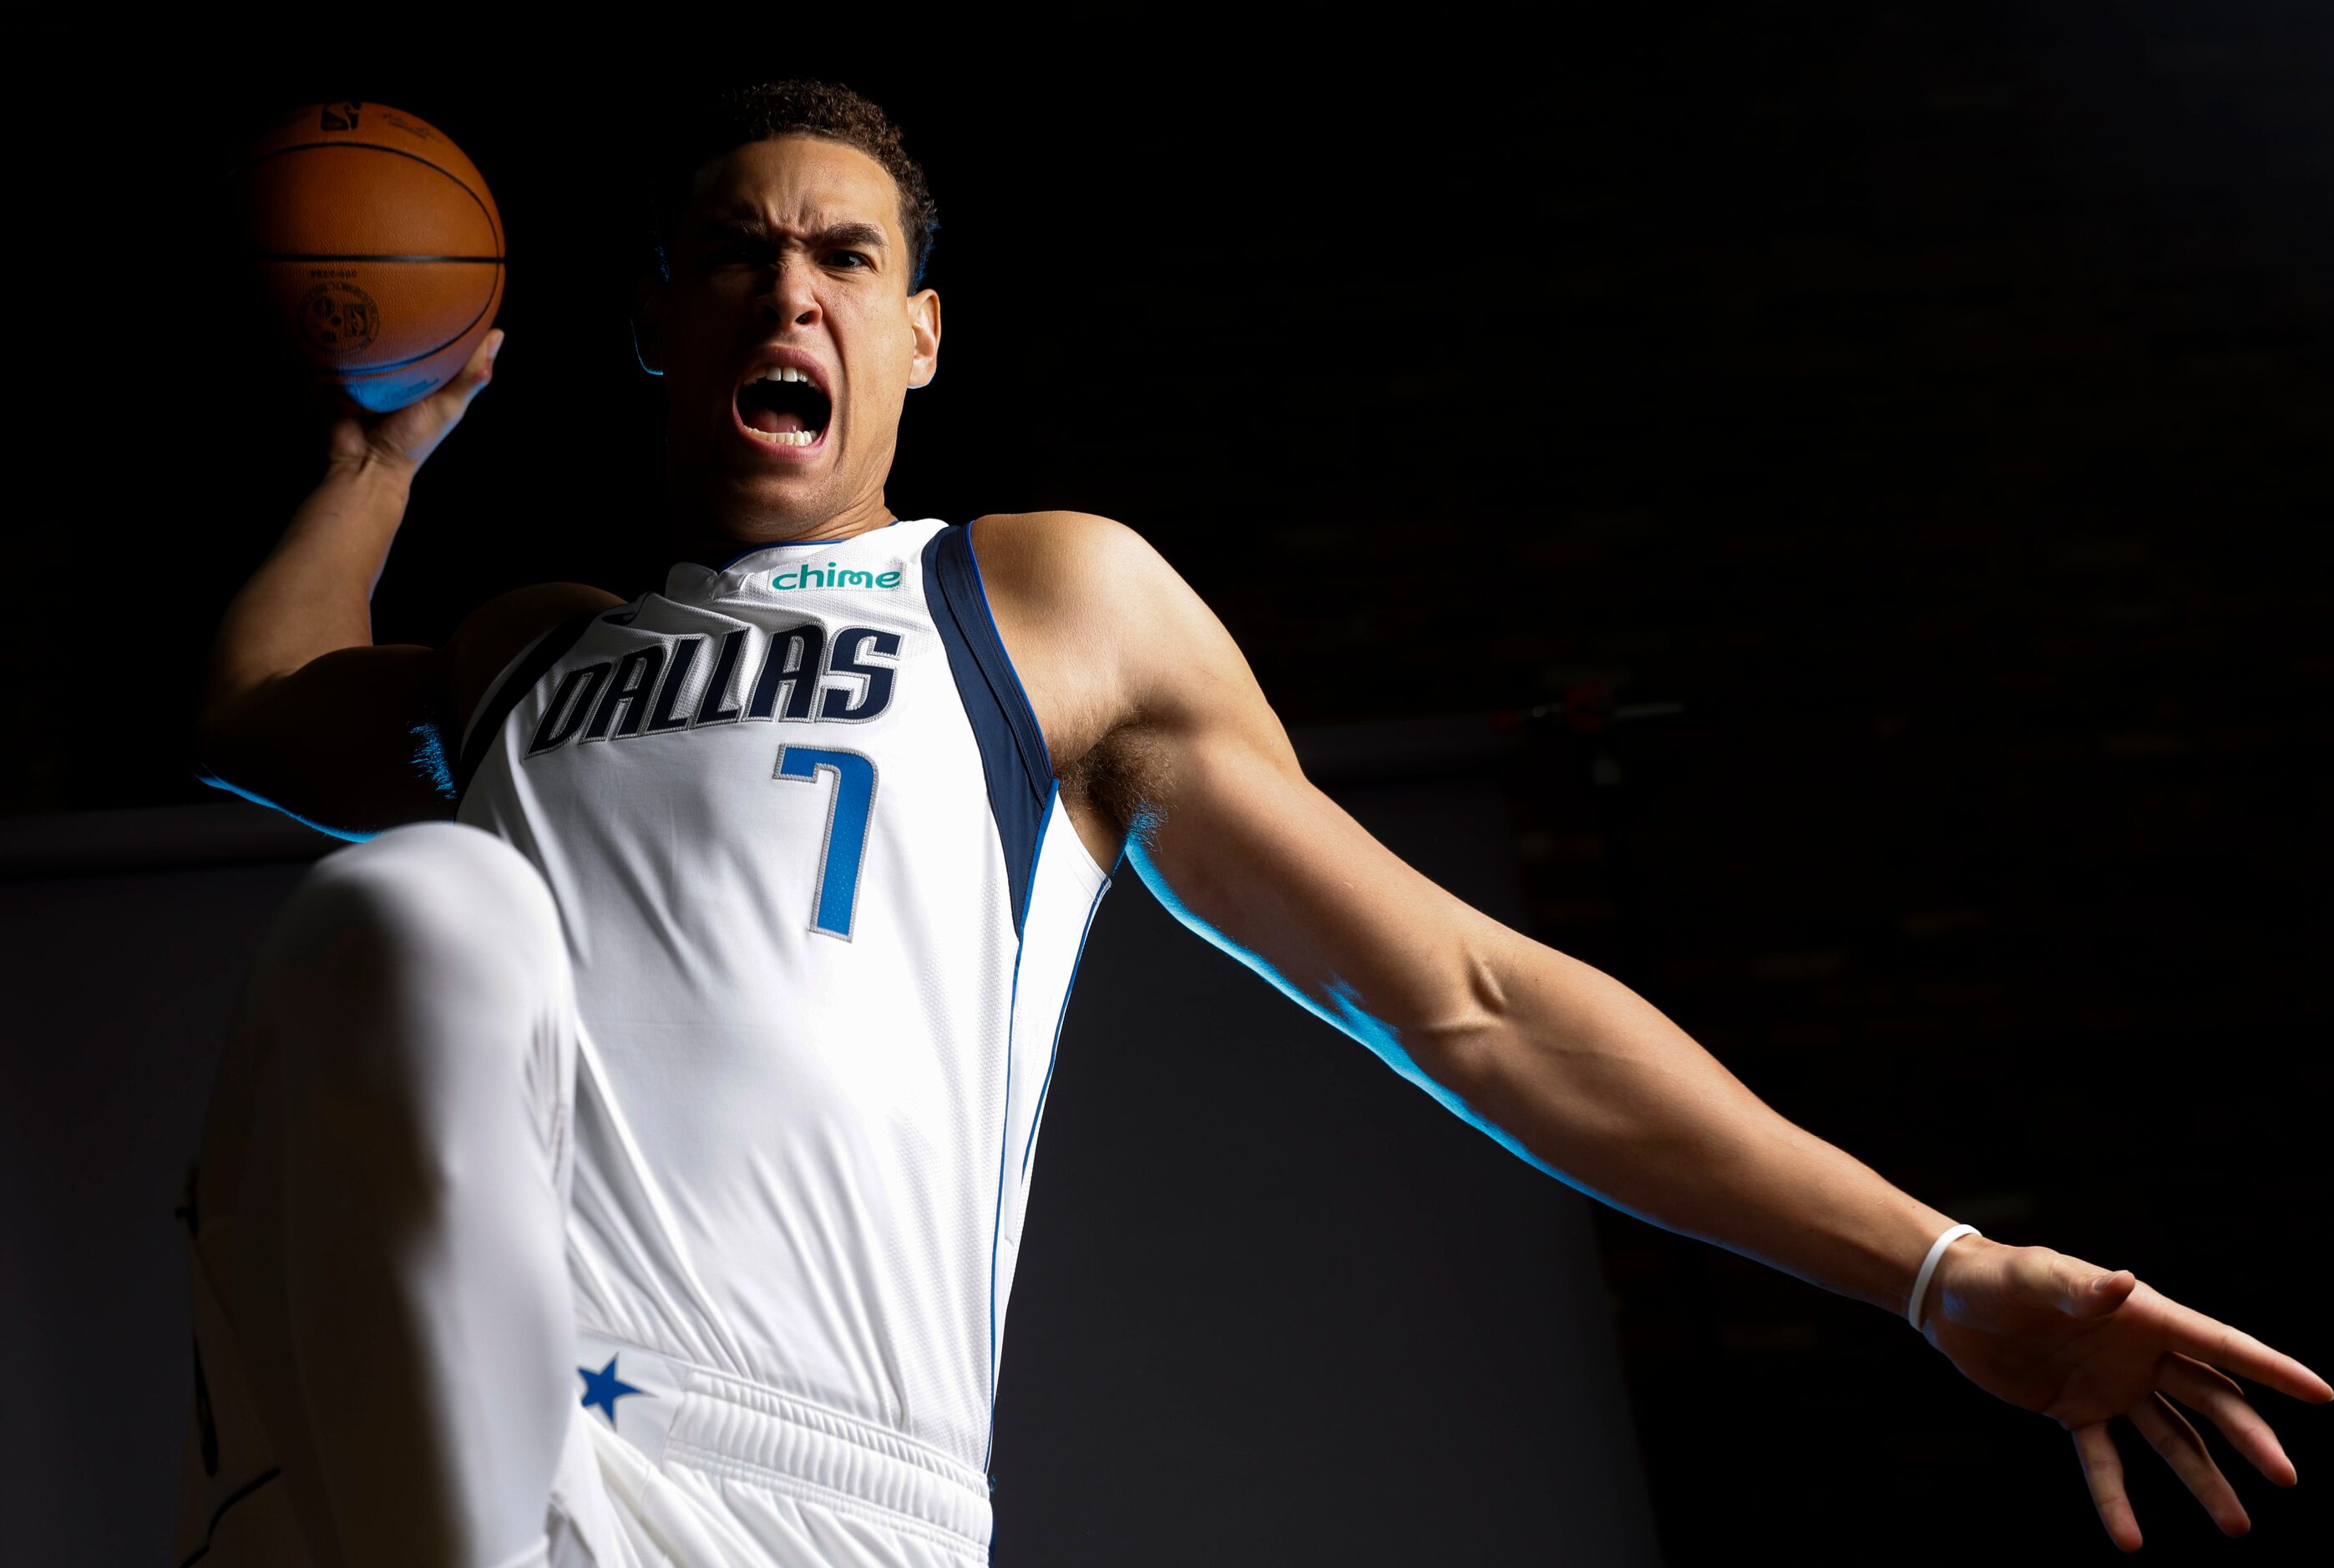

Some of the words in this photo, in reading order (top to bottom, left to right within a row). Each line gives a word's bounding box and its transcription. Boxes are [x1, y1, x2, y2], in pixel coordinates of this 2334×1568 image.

[771, 562, 901, 590] chime
[524, 621, 904, 761] DALLAS
[772, 742, 879, 943] 7
